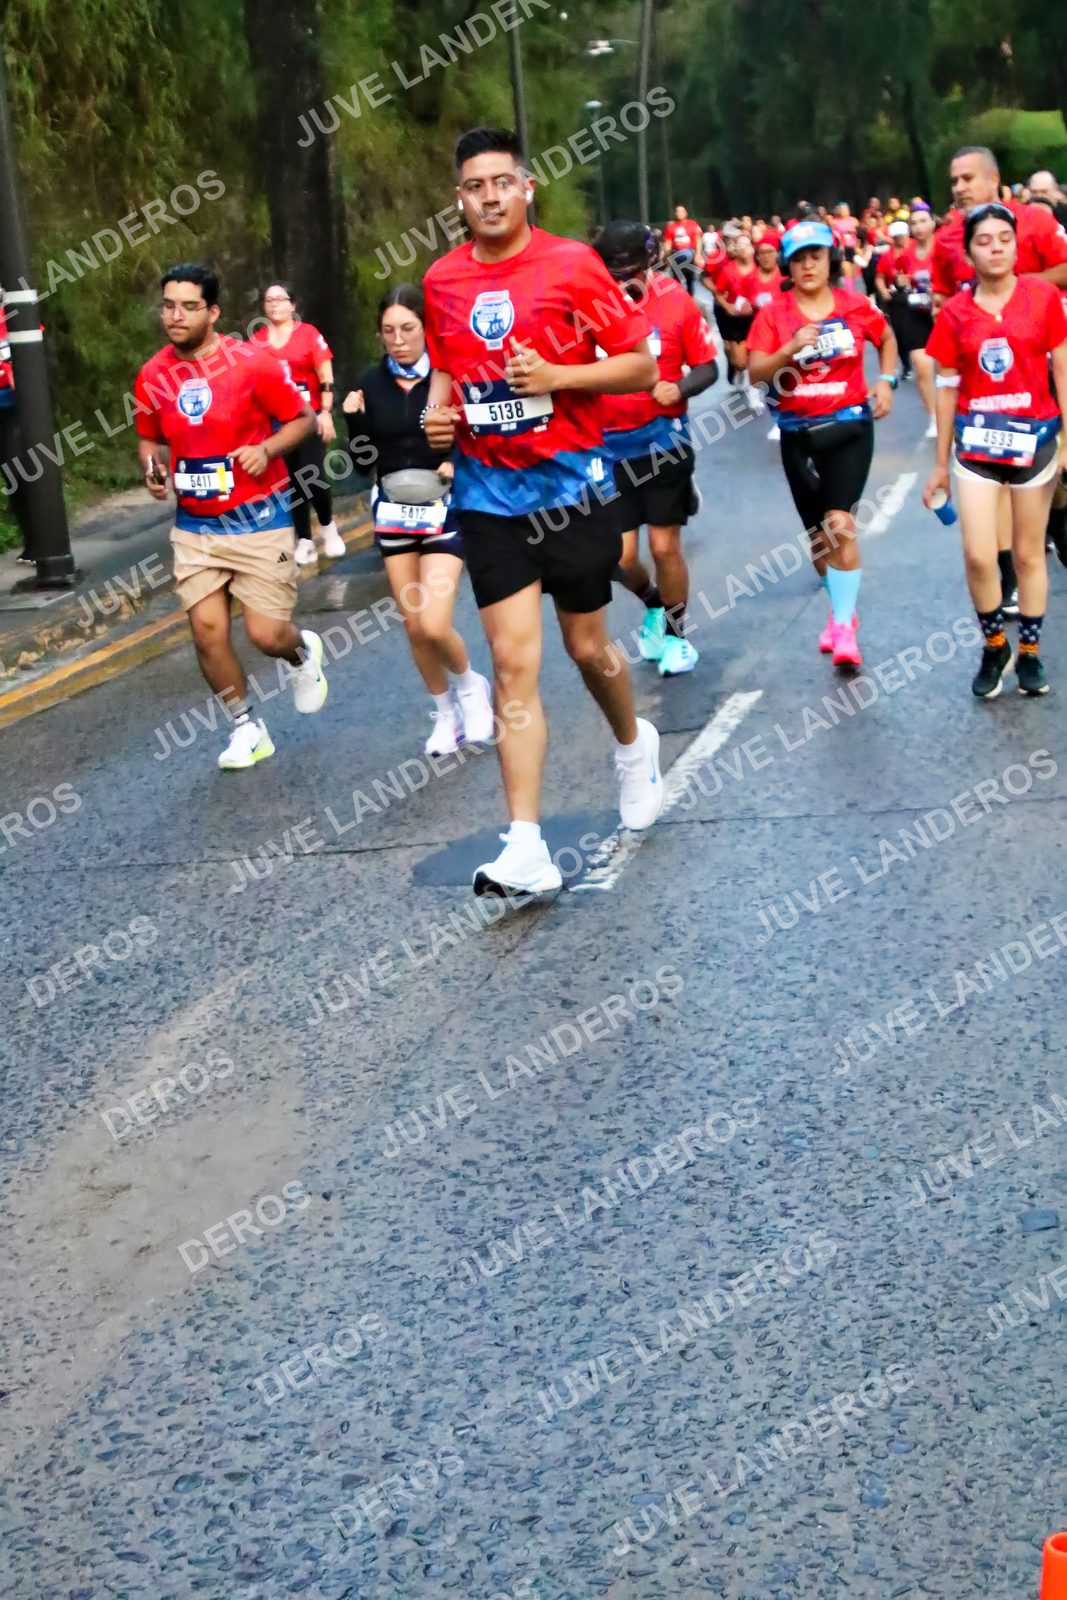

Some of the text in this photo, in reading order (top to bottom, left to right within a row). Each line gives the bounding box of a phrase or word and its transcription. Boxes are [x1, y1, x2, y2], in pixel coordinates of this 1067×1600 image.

[489, 401, 525, 421] 5138
[190, 475, 211, 488] 5411
[401, 505, 426, 520] 5412
